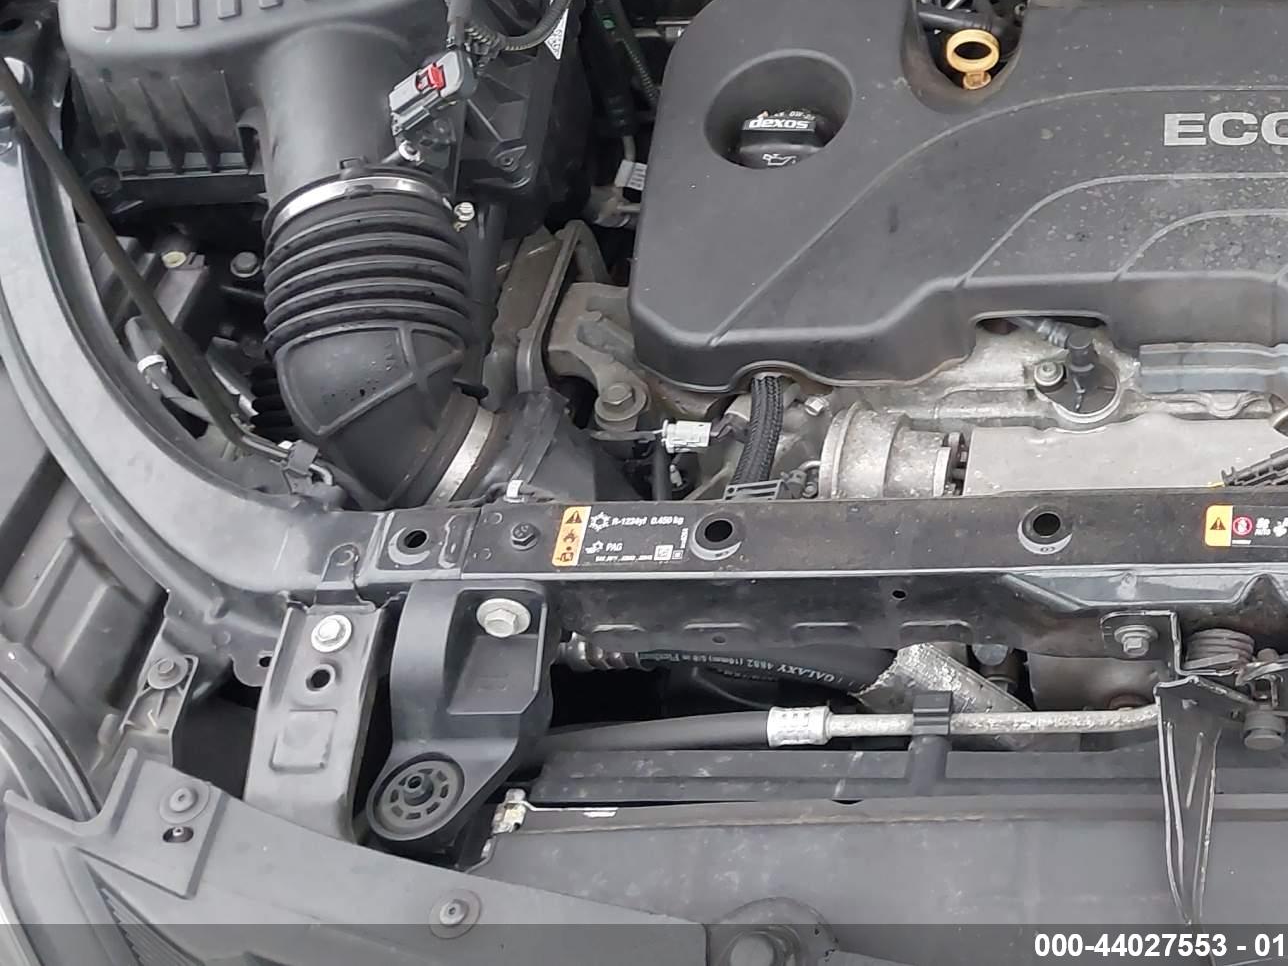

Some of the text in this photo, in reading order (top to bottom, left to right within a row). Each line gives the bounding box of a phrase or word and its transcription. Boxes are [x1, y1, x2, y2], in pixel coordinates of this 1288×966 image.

[748, 116, 810, 129] dexos
[605, 542, 623, 552] PAG
[777, 664, 835, 682] GALAXY
